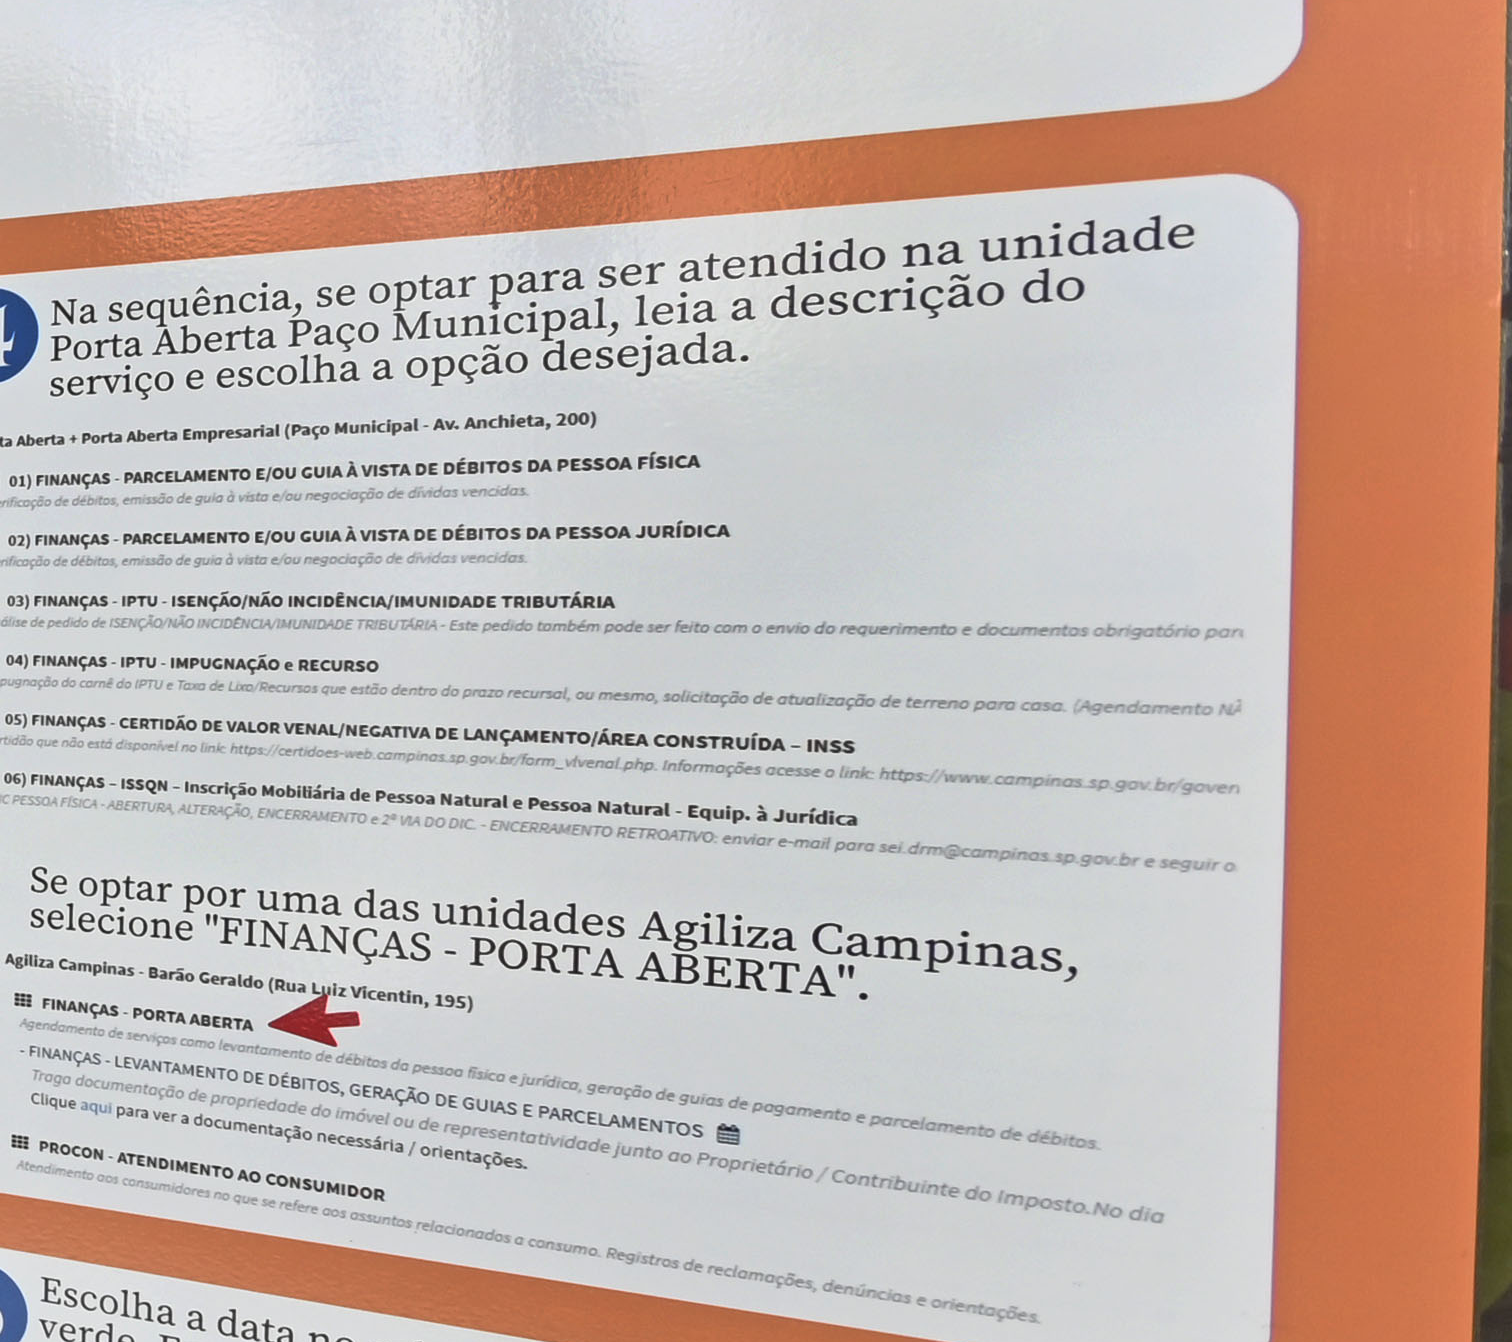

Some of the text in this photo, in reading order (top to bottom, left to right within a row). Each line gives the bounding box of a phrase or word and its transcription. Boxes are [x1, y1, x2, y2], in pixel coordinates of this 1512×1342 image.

[49, 331, 749, 401] serviço e escolha a opção desejada.
[16, 434, 65, 447] Aberta
[81, 431, 123, 445] Porta
[126, 429, 178, 443] Aberta
[182, 423, 280, 444] Empresarial
[284, 423, 330, 440] (Paço
[334, 418, 419, 436] Municipal
[432, 418, 460, 431] Av.
[463, 414, 551, 431] Anchieta,
[556, 411, 597, 429] 200)
[39, 1140, 104, 1161] PROCON
[117, 1152, 234, 1180] ATENDIMENTO
[237, 1169, 261, 1184] AO
[265, 1173, 385, 1202] CONSUMIDOR
